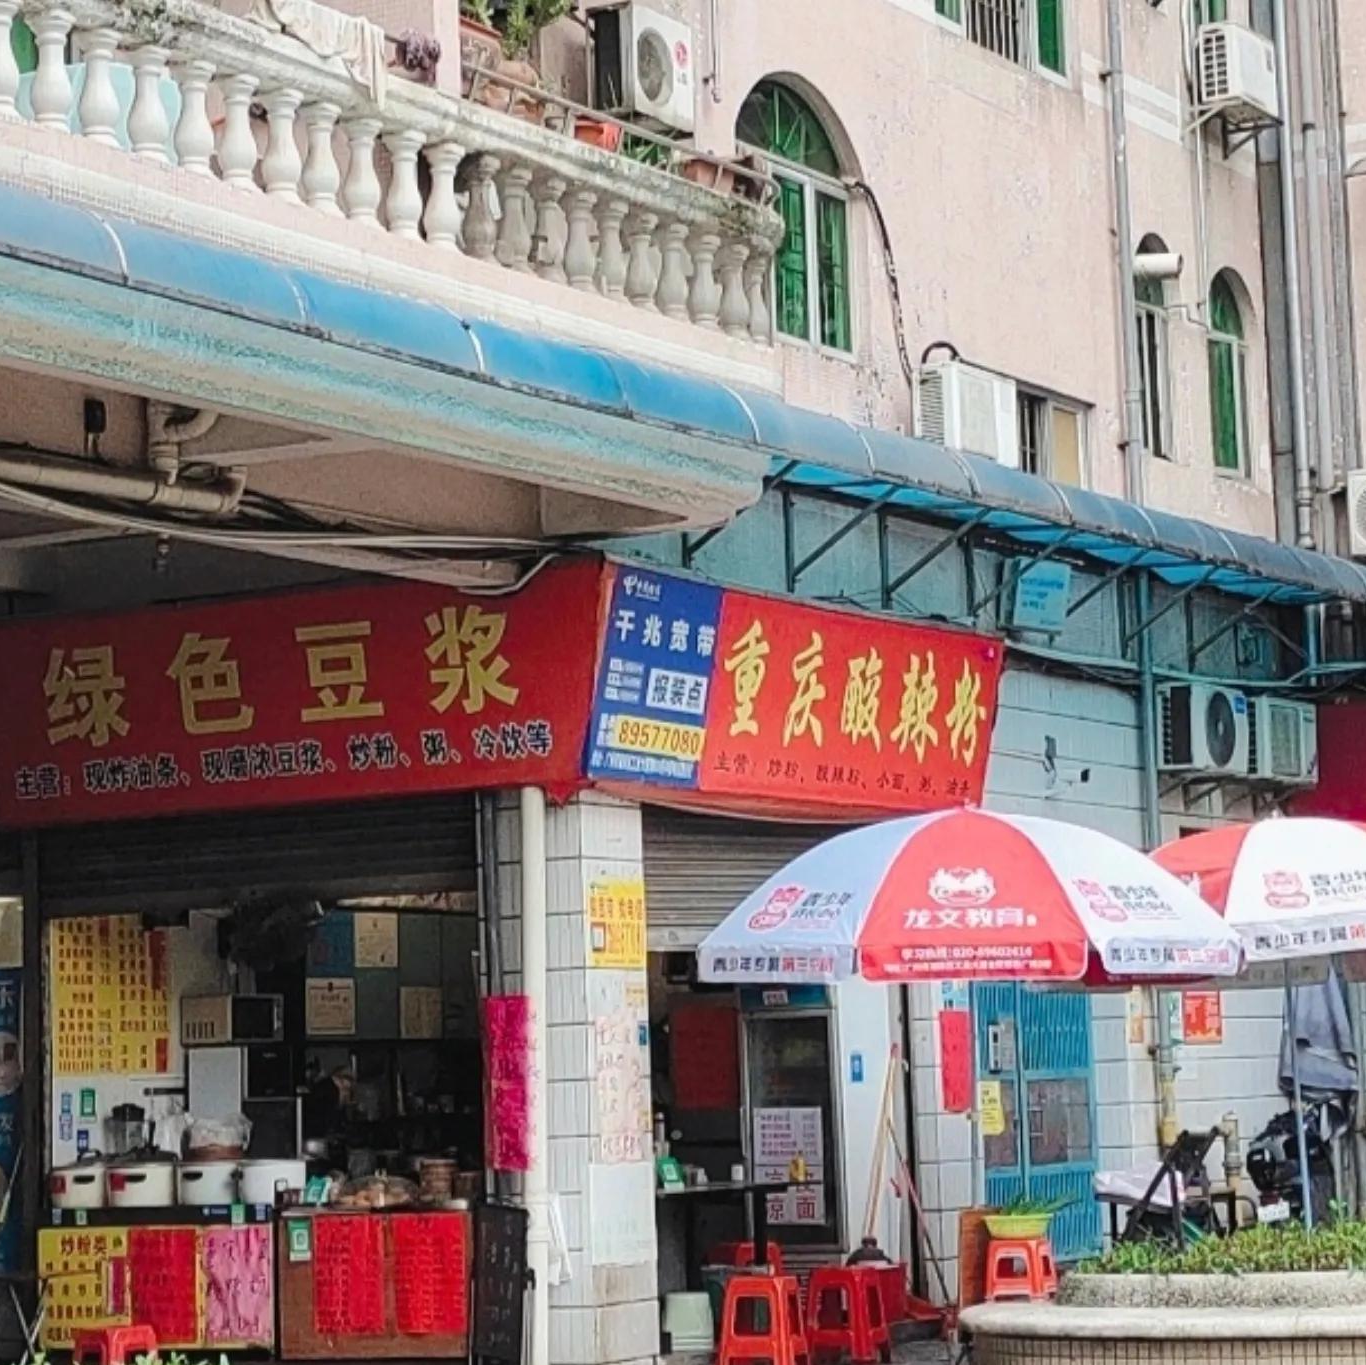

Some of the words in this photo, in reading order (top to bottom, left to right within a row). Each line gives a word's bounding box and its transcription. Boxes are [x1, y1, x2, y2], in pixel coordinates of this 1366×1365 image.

[42, 603, 520, 748] 绿色豆浆
[724, 619, 987, 767] 重庆酸辣粉
[618, 720, 701, 756] 89577080
[903, 908, 1026, 930] 龙文教育
